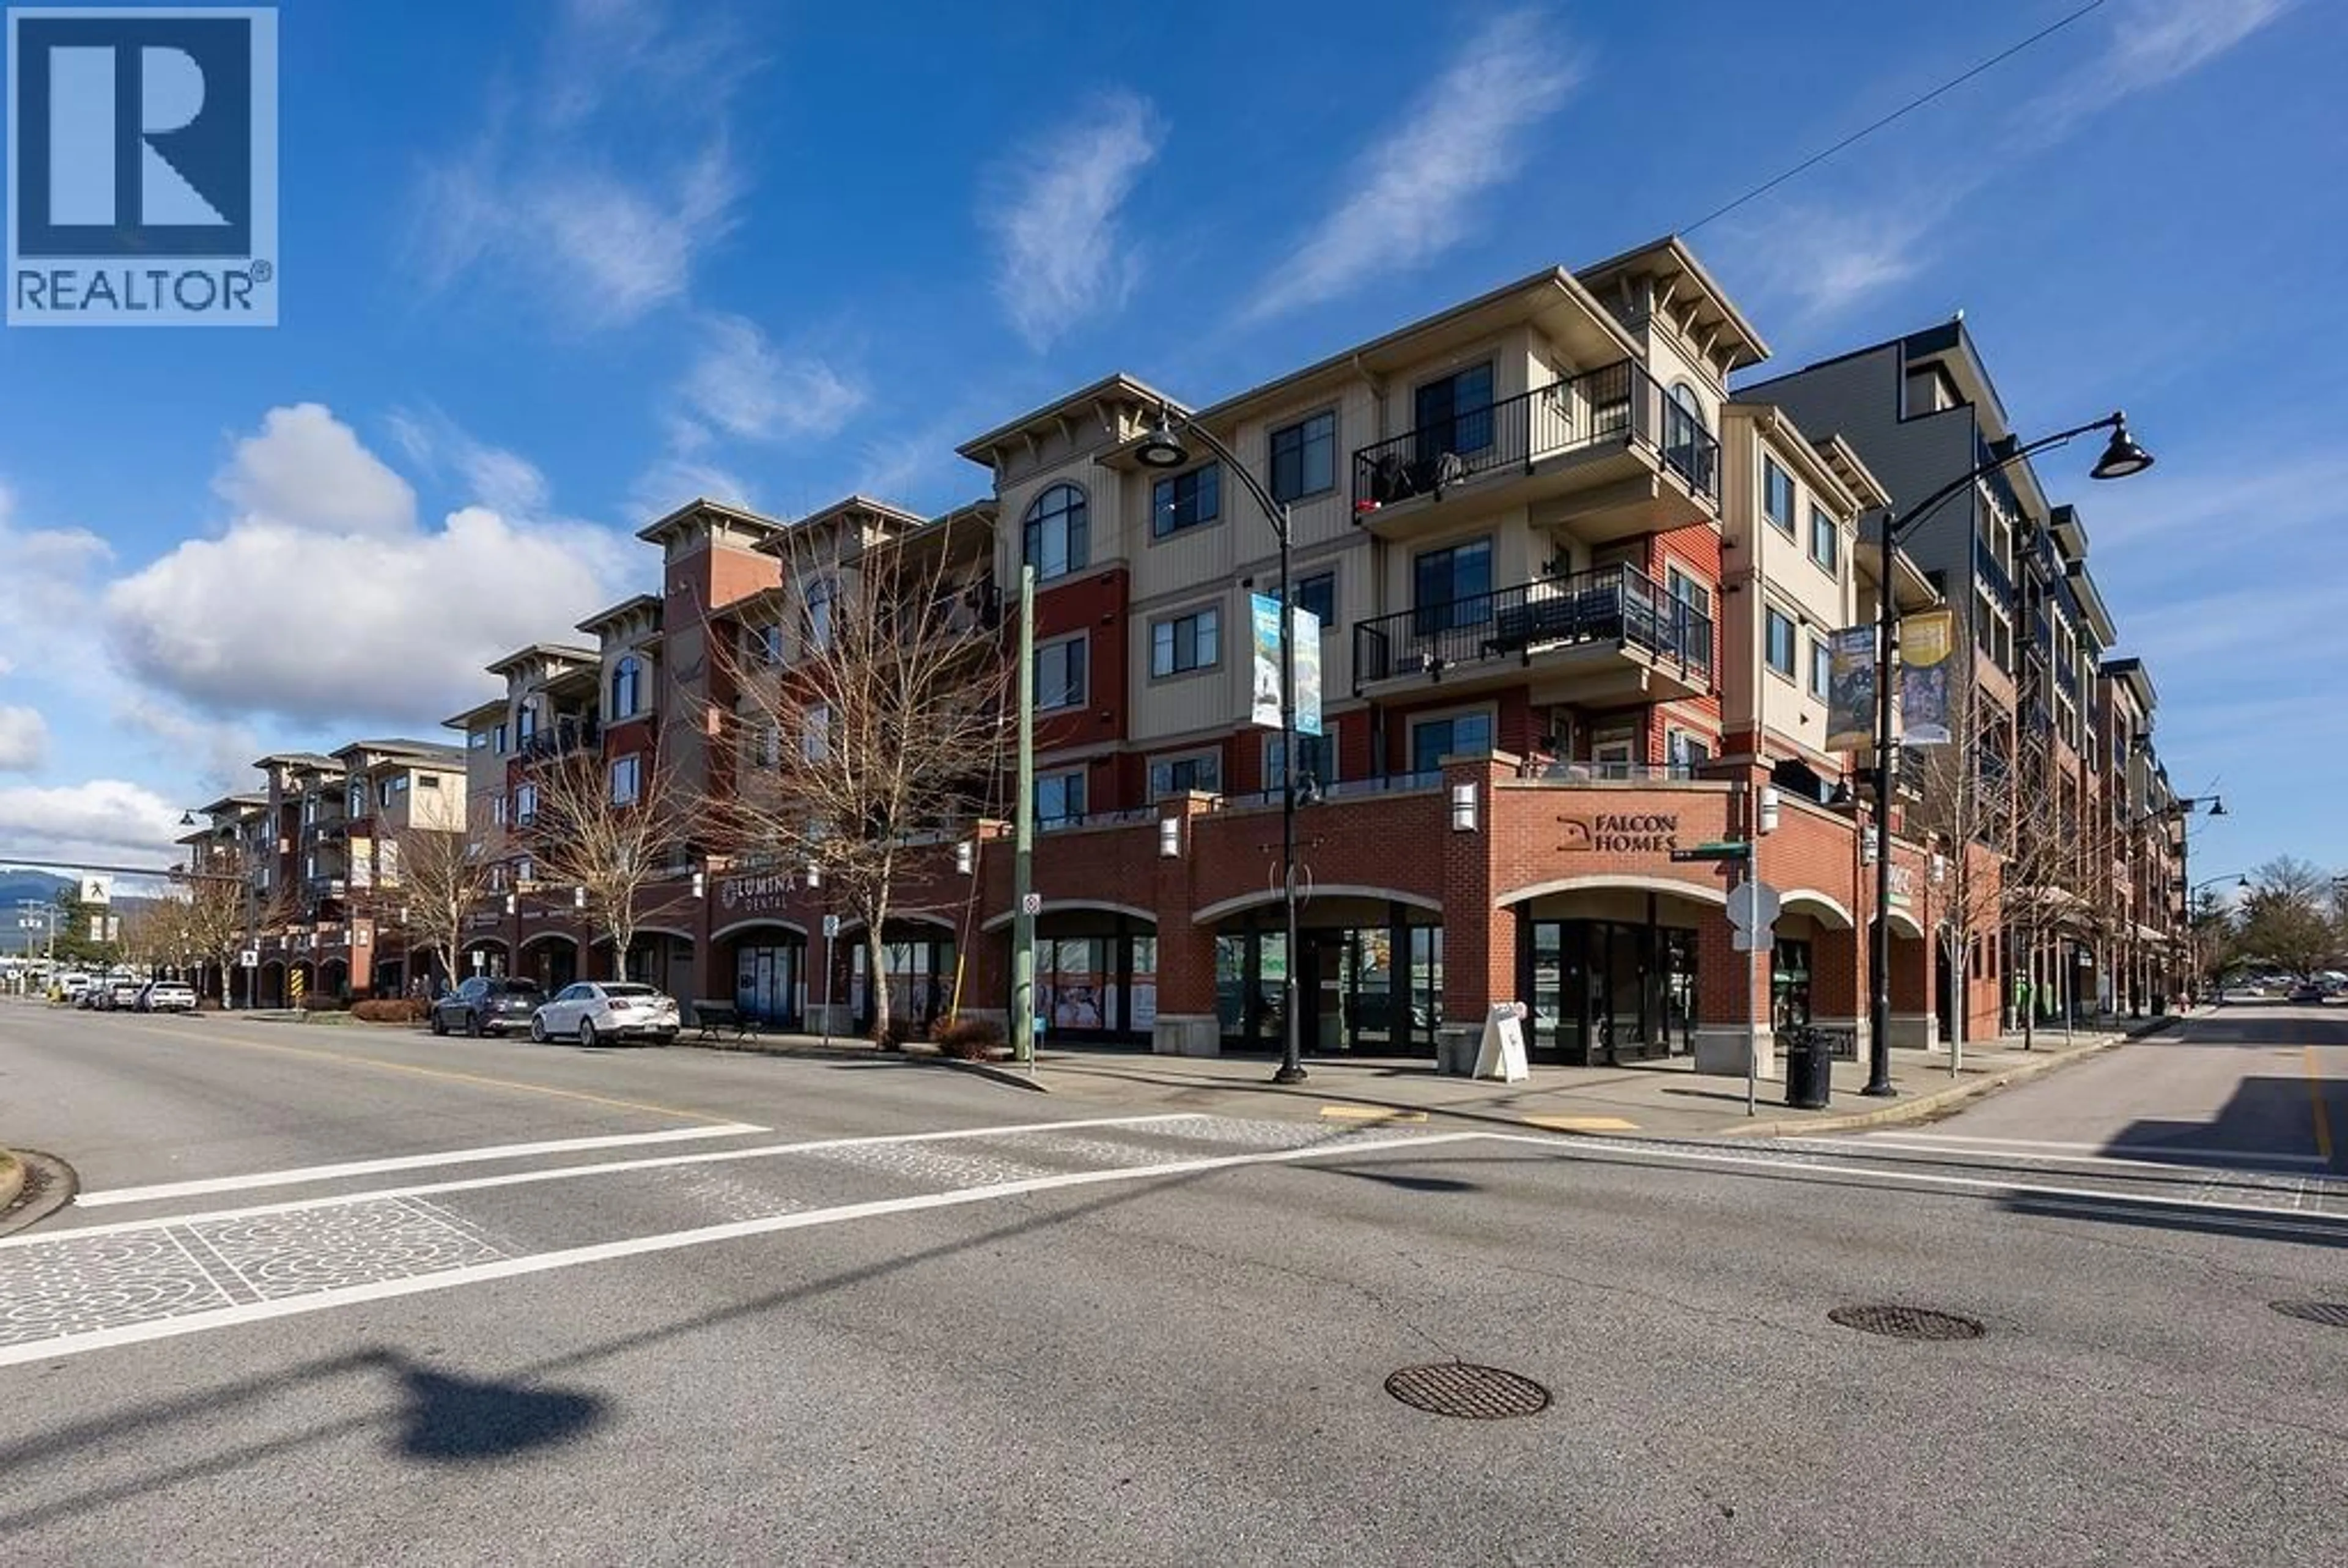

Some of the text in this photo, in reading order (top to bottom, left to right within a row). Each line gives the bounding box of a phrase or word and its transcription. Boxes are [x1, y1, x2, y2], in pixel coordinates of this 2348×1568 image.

[1595, 814, 1677, 833] FALCON
[1595, 834, 1677, 852] HOMES
[738, 874, 797, 897] LUMINA
